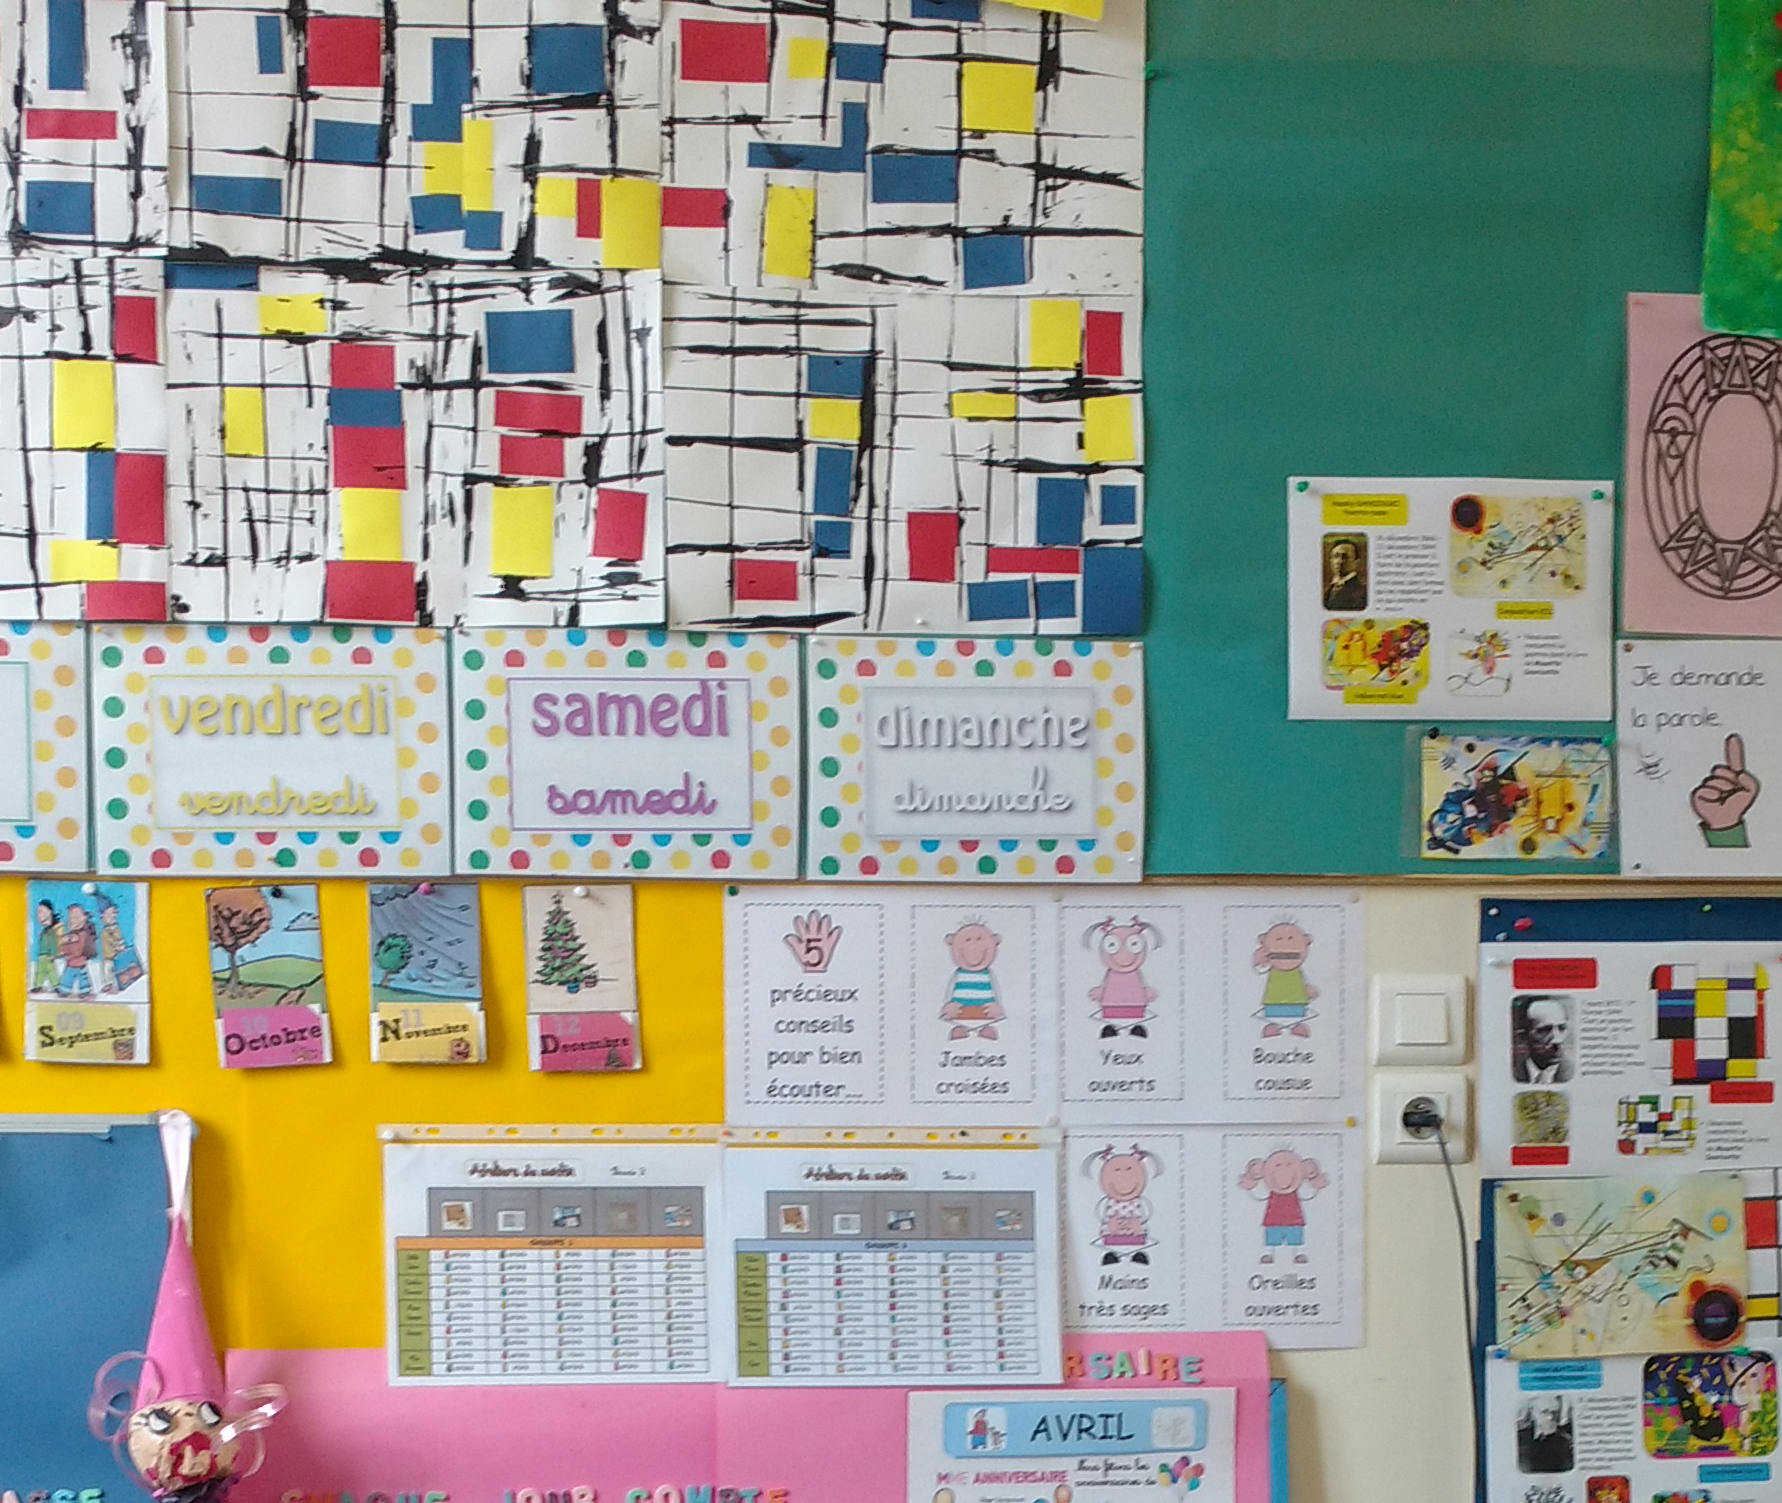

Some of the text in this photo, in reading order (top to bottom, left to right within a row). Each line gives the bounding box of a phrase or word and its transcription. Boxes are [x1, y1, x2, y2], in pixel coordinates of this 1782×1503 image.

[1631, 664, 1767, 688] Je demande
[161, 684, 389, 735] vendredi
[532, 682, 729, 737] samedi
[1631, 707, 1648, 728] la
[876, 705, 1089, 749] dimanche
[180, 775, 376, 815] vendredi
[547, 773, 717, 815] samedi
[894, 765, 1073, 813] dimanche
[804, 937, 823, 969] 5
[770, 984, 859, 1007] précieux
[38, 1020, 135, 1050] Septembre
[379, 1018, 469, 1043] Novembre
[774, 1015, 854, 1034] conseils
[225, 1023, 323, 1056] Octobre
[768, 1045, 862, 1068] pour bien
[938, 1050, 1007, 1068] Jambes
[1099, 1048, 1143, 1066] Yeux
[1253, 1047, 1315, 1065] Bouche
[935, 1075, 1010, 1094] croisées
[1088, 1075, 1156, 1093] ouverts
[1255, 1076, 1312, 1092] cousue
[1097, 1274, 1149, 1291] Mains
[1247, 1273, 1318, 1291] Oreilles
[1079, 1300, 1169, 1321] très sages
[1246, 1301, 1320, 1318] ouvertes
[1030, 1412, 1136, 1443] AVRIL
[973, 1469, 1069, 1485] ANNIVERSAIRE
